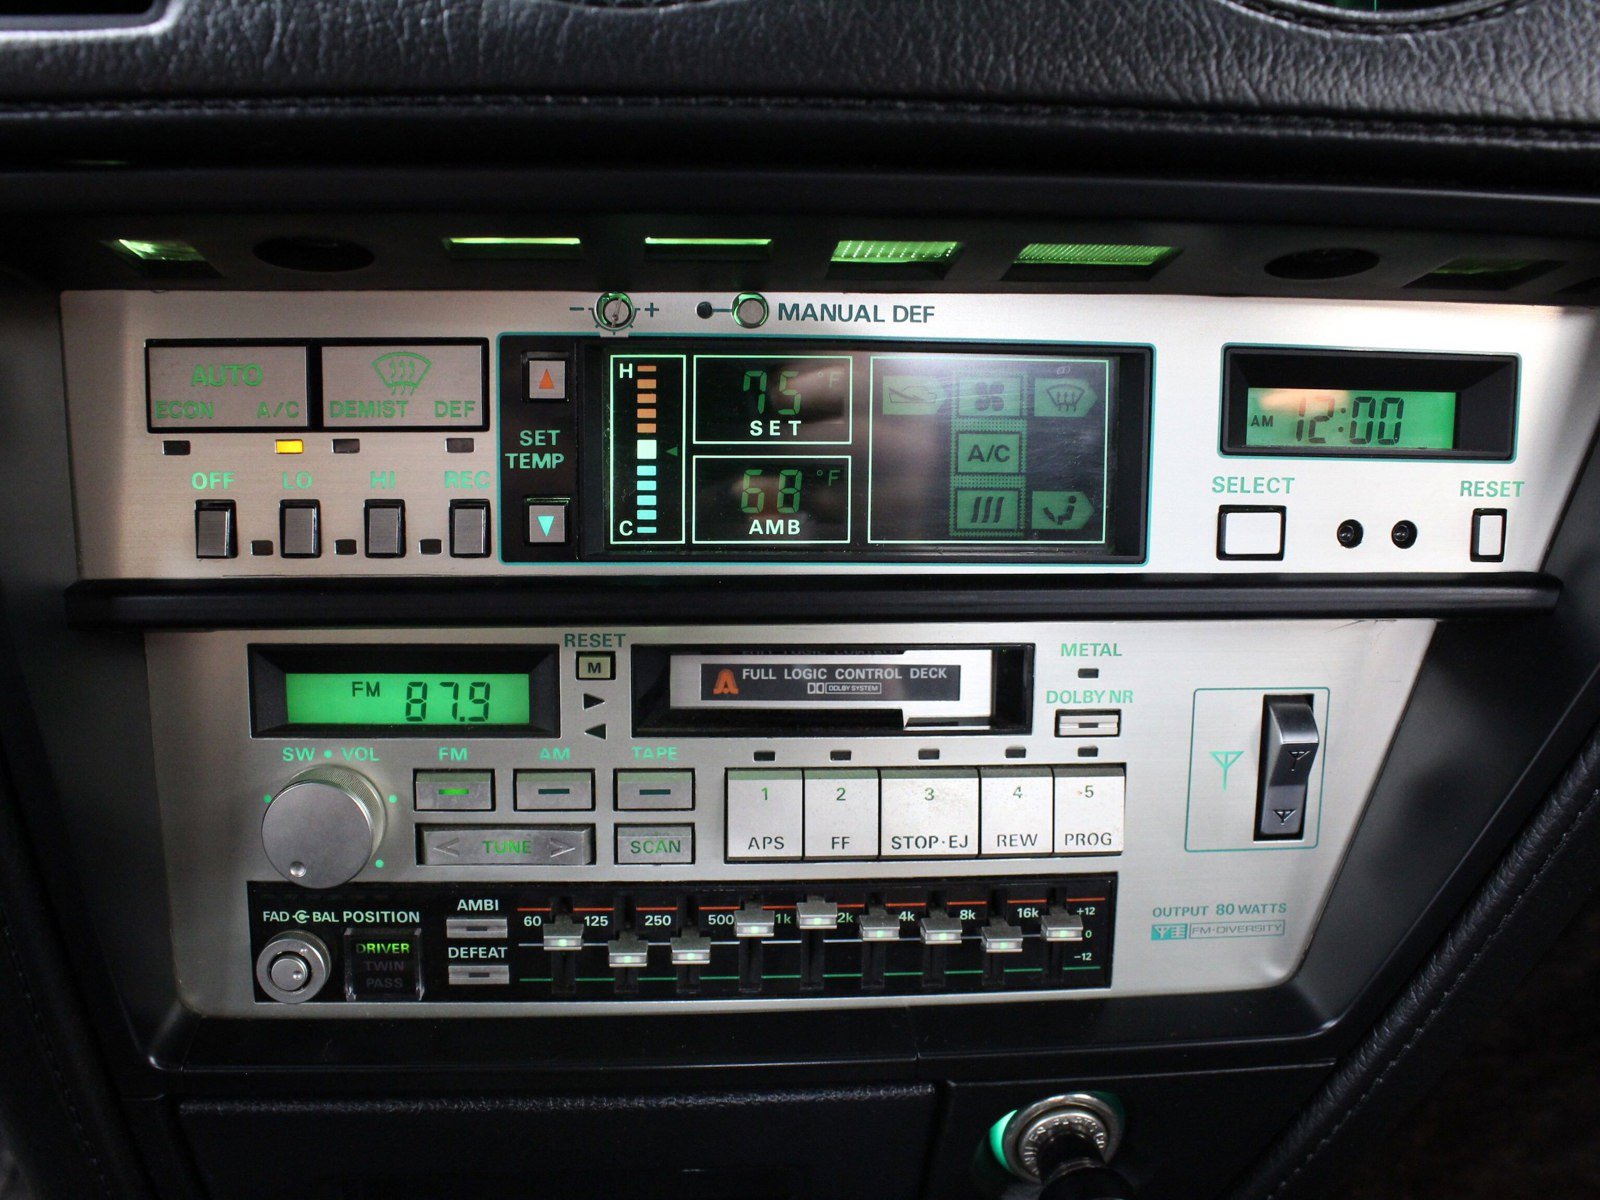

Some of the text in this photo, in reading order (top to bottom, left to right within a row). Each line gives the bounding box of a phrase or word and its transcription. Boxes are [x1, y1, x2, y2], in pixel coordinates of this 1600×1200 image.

[777, 303, 935, 323] MANUAL DEF
[190, 363, 263, 387] AUTO
[618, 363, 633, 379] H
[743, 370, 801, 416] 75
[155, 399, 214, 419] ECON
[256, 400, 300, 418] A/C
[329, 400, 408, 418] DEMIST
[434, 400, 476, 418] DEF
[750, 420, 802, 436] SET
[1251, 415, 1274, 427] AM
[1295, 396, 1405, 446] 12:00
[519, 429, 561, 447] SET
[967, 444, 1010, 462] A/C
[505, 452, 565, 470] TEMP
[191, 471, 235, 490] OFF
[282, 471, 313, 490] LO
[370, 471, 396, 489] HI
[444, 471, 491, 490] REC
[1211, 476, 1295, 494] SELECT
[741, 469, 803, 514] 68
[1459, 480, 1525, 497] RESET
[619, 520, 634, 536] C
[748, 519, 801, 535] AMB
[564, 633, 626, 648] RESET
[1060, 642, 1122, 657] METAL
[587, 662, 601, 674] M
[742, 667, 948, 680] FULL LOGIC CONTROL DECK
[351, 681, 491, 722] FM 87.9
[1045, 689, 1134, 705] DOLBY NR
[282, 747, 380, 762] SW VOL
[438, 747, 468, 761] FM
[539, 747, 570, 761] AM
[631, 746, 678, 761] TAPE
[760, 786, 769, 801] 1
[835, 786, 847, 801] 2
[924, 786, 935, 800] 3
[1012, 785, 1024, 799] 4
[1083, 784, 1094, 798] 5
[482, 840, 532, 854] TUNE
[630, 838, 682, 854] SCAN
[747, 835, 785, 851] APS
[831, 835, 850, 850] FF
[996, 833, 1038, 848] REW
[1064, 832, 1113, 847] PROG
[456, 899, 499, 912] AMBI
[1016, 907, 1039, 918] 16k
[1076, 906, 1096, 916] +12
[1152, 902, 1287, 918] OUTPUT 80 WATTS
[262, 911, 339, 923] FAD BAL
[343, 911, 420, 923] POSITION
[523, 915, 542, 927] 60
[584, 915, 609, 927] 125
[644, 915, 672, 926] 250
[708, 914, 734, 925] 500
[775, 913, 791, 924] 1k
[837, 912, 853, 923] 2k
[898, 911, 915, 922] 4k
[959, 909, 976, 920] 8k
[1085, 930, 1092, 938] 0
[1191, 923, 1282, 935] FM-DIVERSITY
[355, 943, 410, 954] DRIVER
[447, 946, 507, 959] DEFEAT
[363, 960, 405, 971] TWIN
[366, 977, 404, 988] PASS
